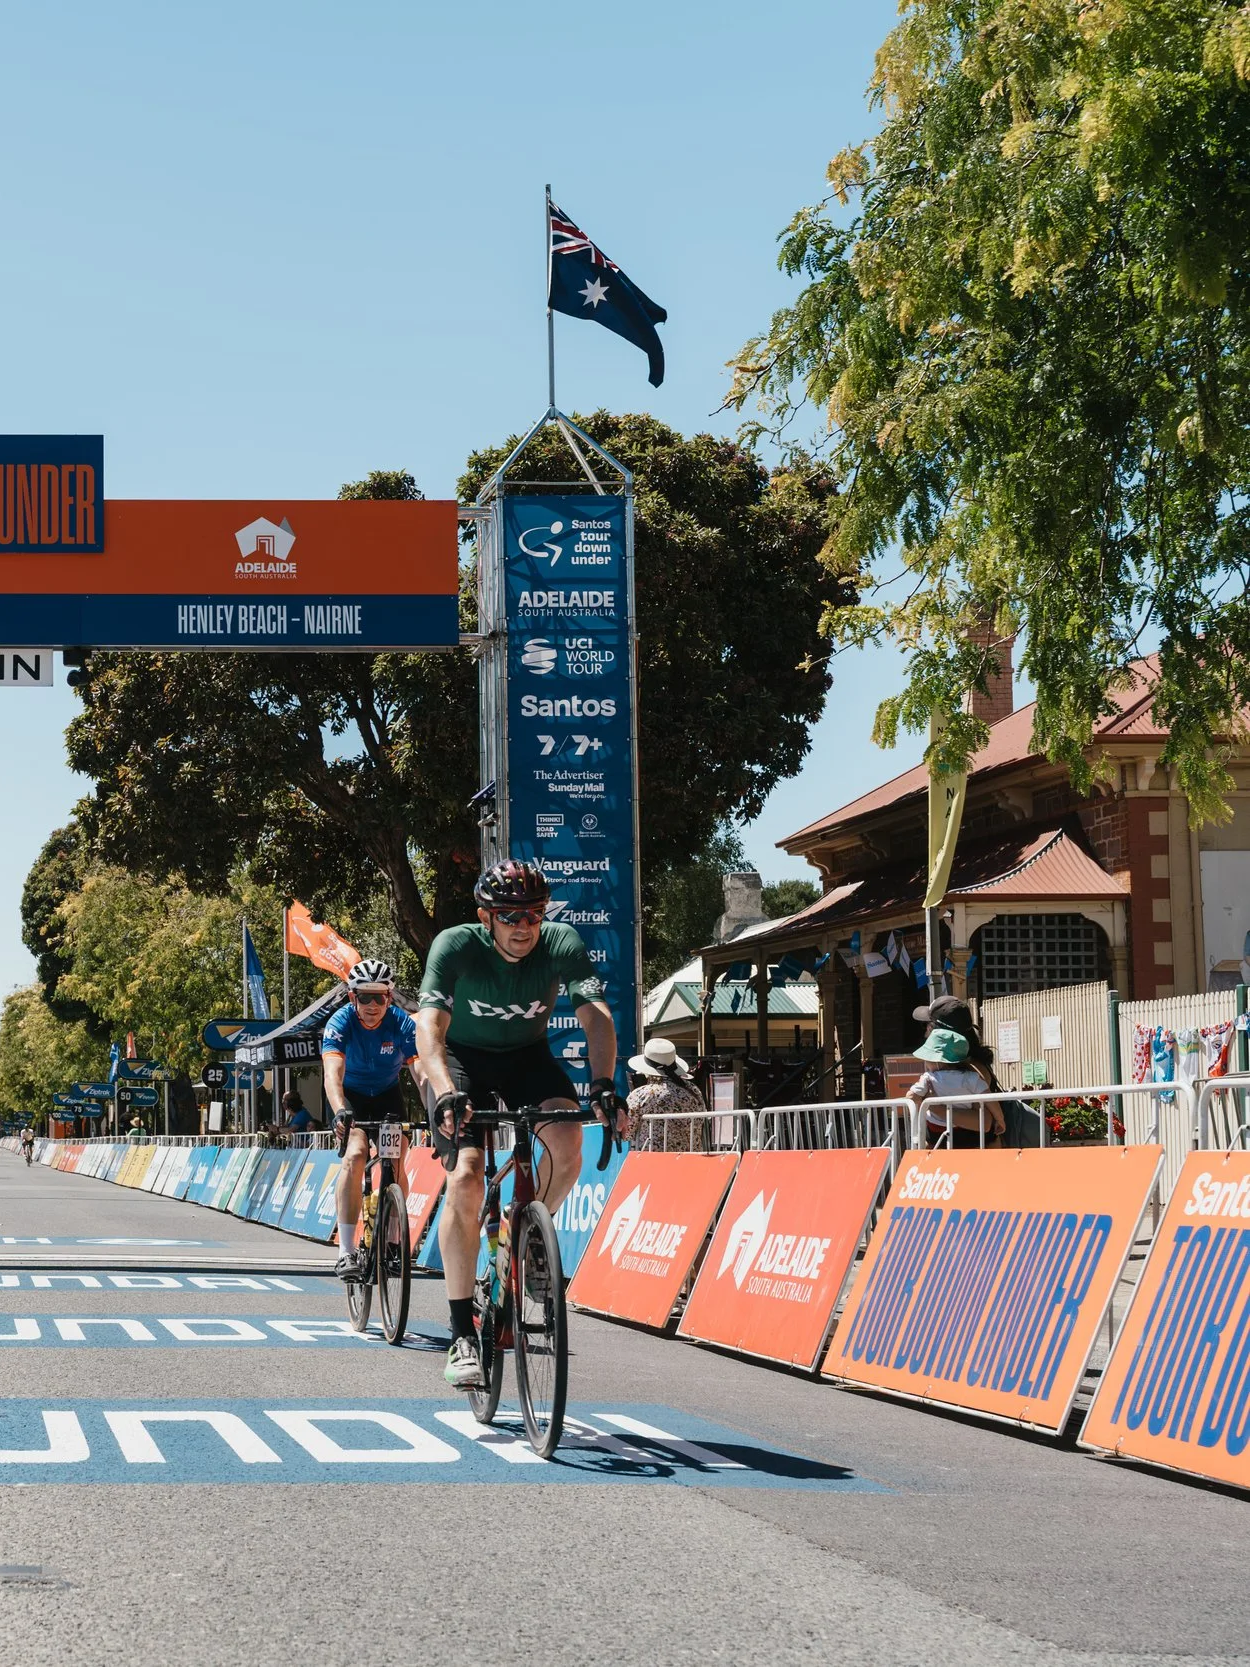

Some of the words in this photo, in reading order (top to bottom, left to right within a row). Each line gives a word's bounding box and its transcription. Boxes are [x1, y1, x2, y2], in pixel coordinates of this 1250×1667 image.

[571, 519, 611, 529] Santos
[580, 531, 611, 541] tour
[574, 543, 610, 552] down
[571, 555, 611, 565] under
[234, 561, 297, 574] ADELAIDE
[518, 591, 614, 607] ADELAIDE
[178, 604, 233, 634] HENLEY
[238, 604, 287, 635] BEACH
[304, 604, 362, 635] NAIRNE
[518, 608, 553, 617] SOUTH
[558, 608, 615, 617] AUSTRALIA
[565, 638, 593, 649] UCI
[566, 651, 614, 662] WORLD
[566, 663, 603, 675] TOUR
[521, 695, 616, 717] Santos
[533, 770, 552, 780] The
[553, 770, 604, 780] Advertiser
[548, 783, 584, 794] Sunday
[584, 783, 604, 792] Mail
[533, 857, 610, 875] Vanguard
[560, 910, 609, 924] Ziptrak
[284, 1040, 316, 1058] RIDE
[208, 1070, 223, 1081] 25
[120, 1092, 130, 1100] 50
[381, 1133, 400, 1147] 0312
[899, 1165, 960, 1200] Santos
[555, 1182, 606, 1232] ntos
[631, 1220, 687, 1259] ADELAIDE
[755, 1233, 832, 1279] ADELAIDE
[618, 1254, 638, 1272] SOUTH
[638, 1258, 671, 1278] AUSTRALIA
[746, 1275, 769, 1296] SOUTH
[771, 1279, 813, 1303] AUSTRALIA
[841, 1206, 943, 1368] TOUR
[894, 1208, 1023, 1382] DOWN
[966, 1212, 1113, 1401] UNDER
